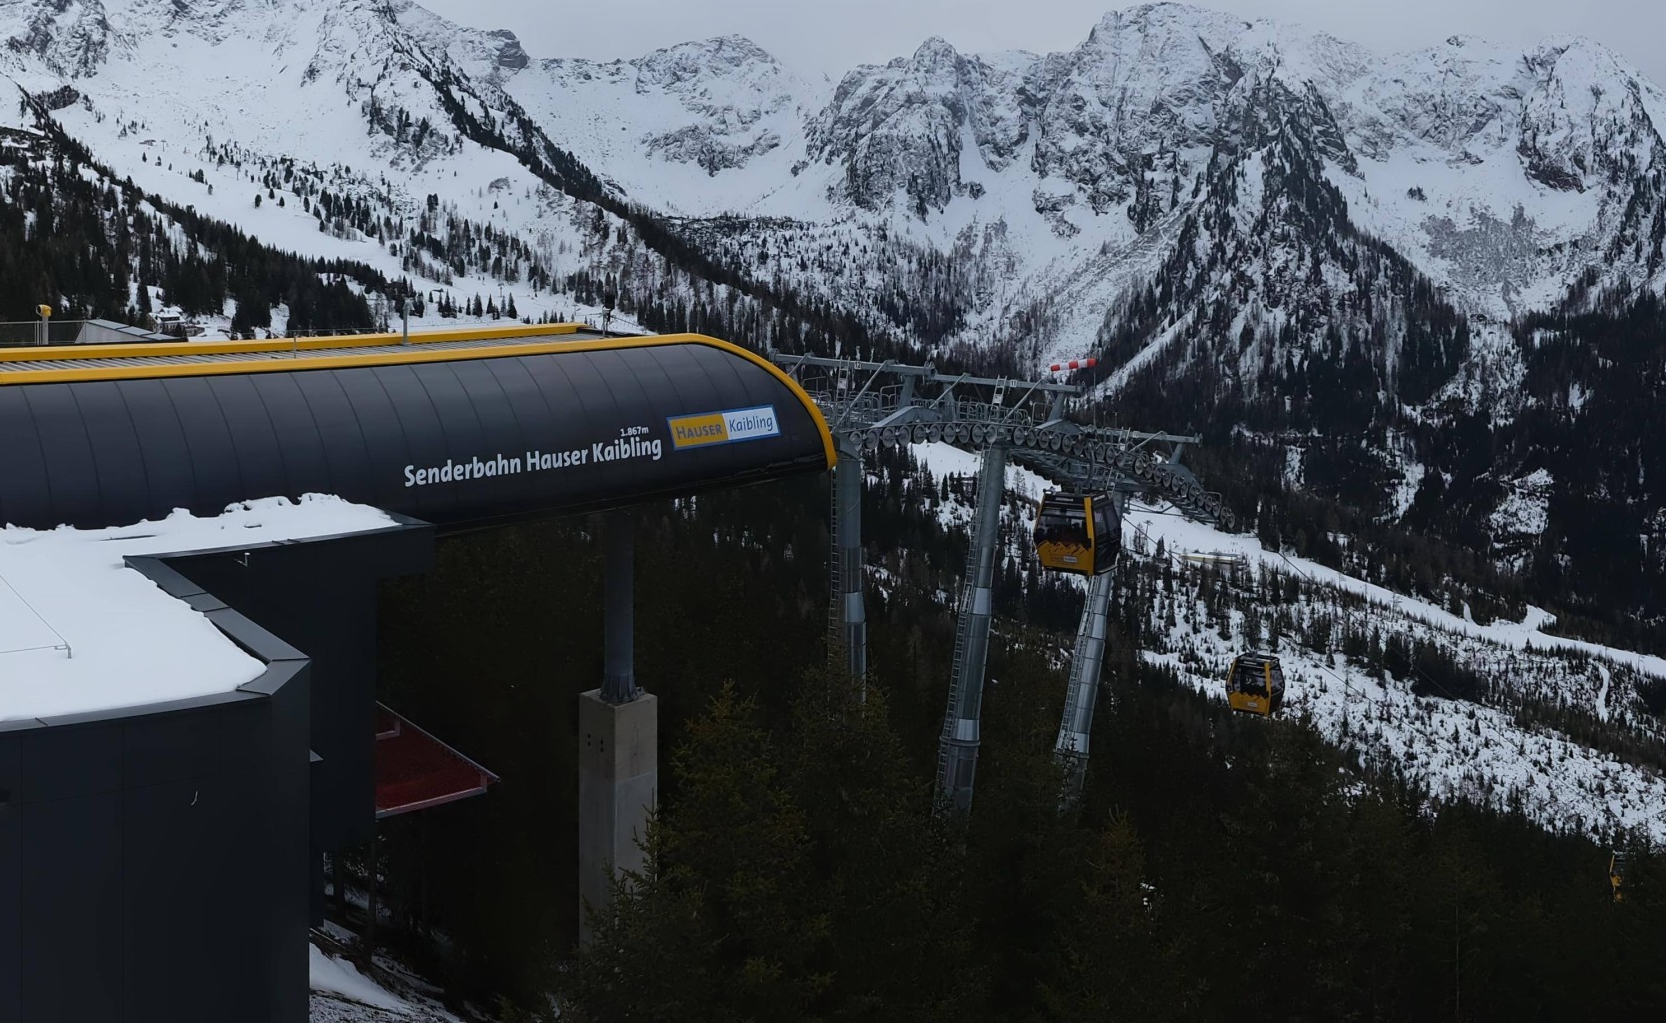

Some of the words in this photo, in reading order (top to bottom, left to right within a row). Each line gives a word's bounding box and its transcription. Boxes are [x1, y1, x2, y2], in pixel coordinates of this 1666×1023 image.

[620, 426, 649, 437] 1.867m
[675, 423, 723, 440] HAUSER
[729, 415, 773, 433] Kaibling
[404, 452, 521, 487] Senderbahn
[526, 447, 589, 472] Hauser
[592, 436, 662, 463] Kaibling
